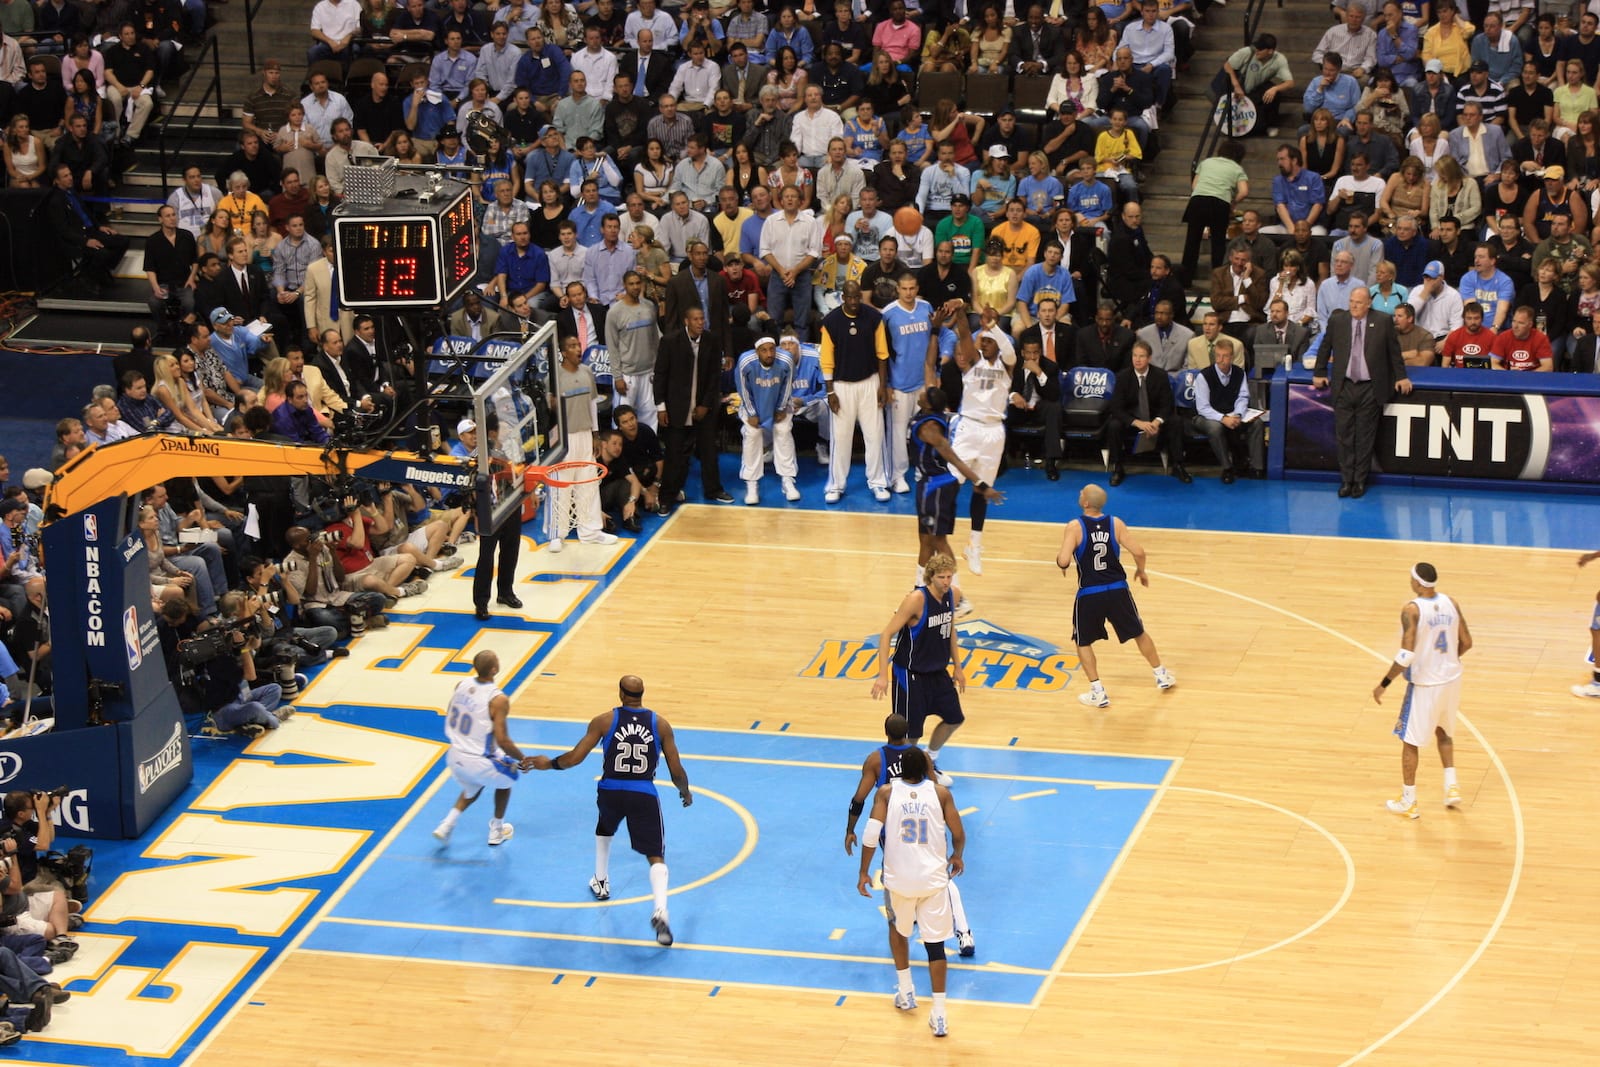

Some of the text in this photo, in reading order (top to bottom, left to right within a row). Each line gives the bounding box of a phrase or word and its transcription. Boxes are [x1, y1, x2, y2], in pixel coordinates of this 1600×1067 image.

[364, 225, 427, 248] 7:11
[379, 259, 416, 296] 12
[899, 322, 929, 336] DENVER
[1082, 372, 1107, 386] NBA
[1073, 384, 1107, 398] Cares
[1383, 403, 1522, 462] TNT
[160, 438, 220, 456] SPALDING
[1090, 531, 1110, 543] KIDD
[1093, 543, 1107, 571] 2
[928, 611, 952, 628] DALLAS
[1434, 630, 1448, 654] 4
[614, 723, 655, 744] DAMPIER
[144, 736, 183, 784] PLAYOFFS
[614, 742, 650, 774] 25
[901, 818, 929, 845] 31
